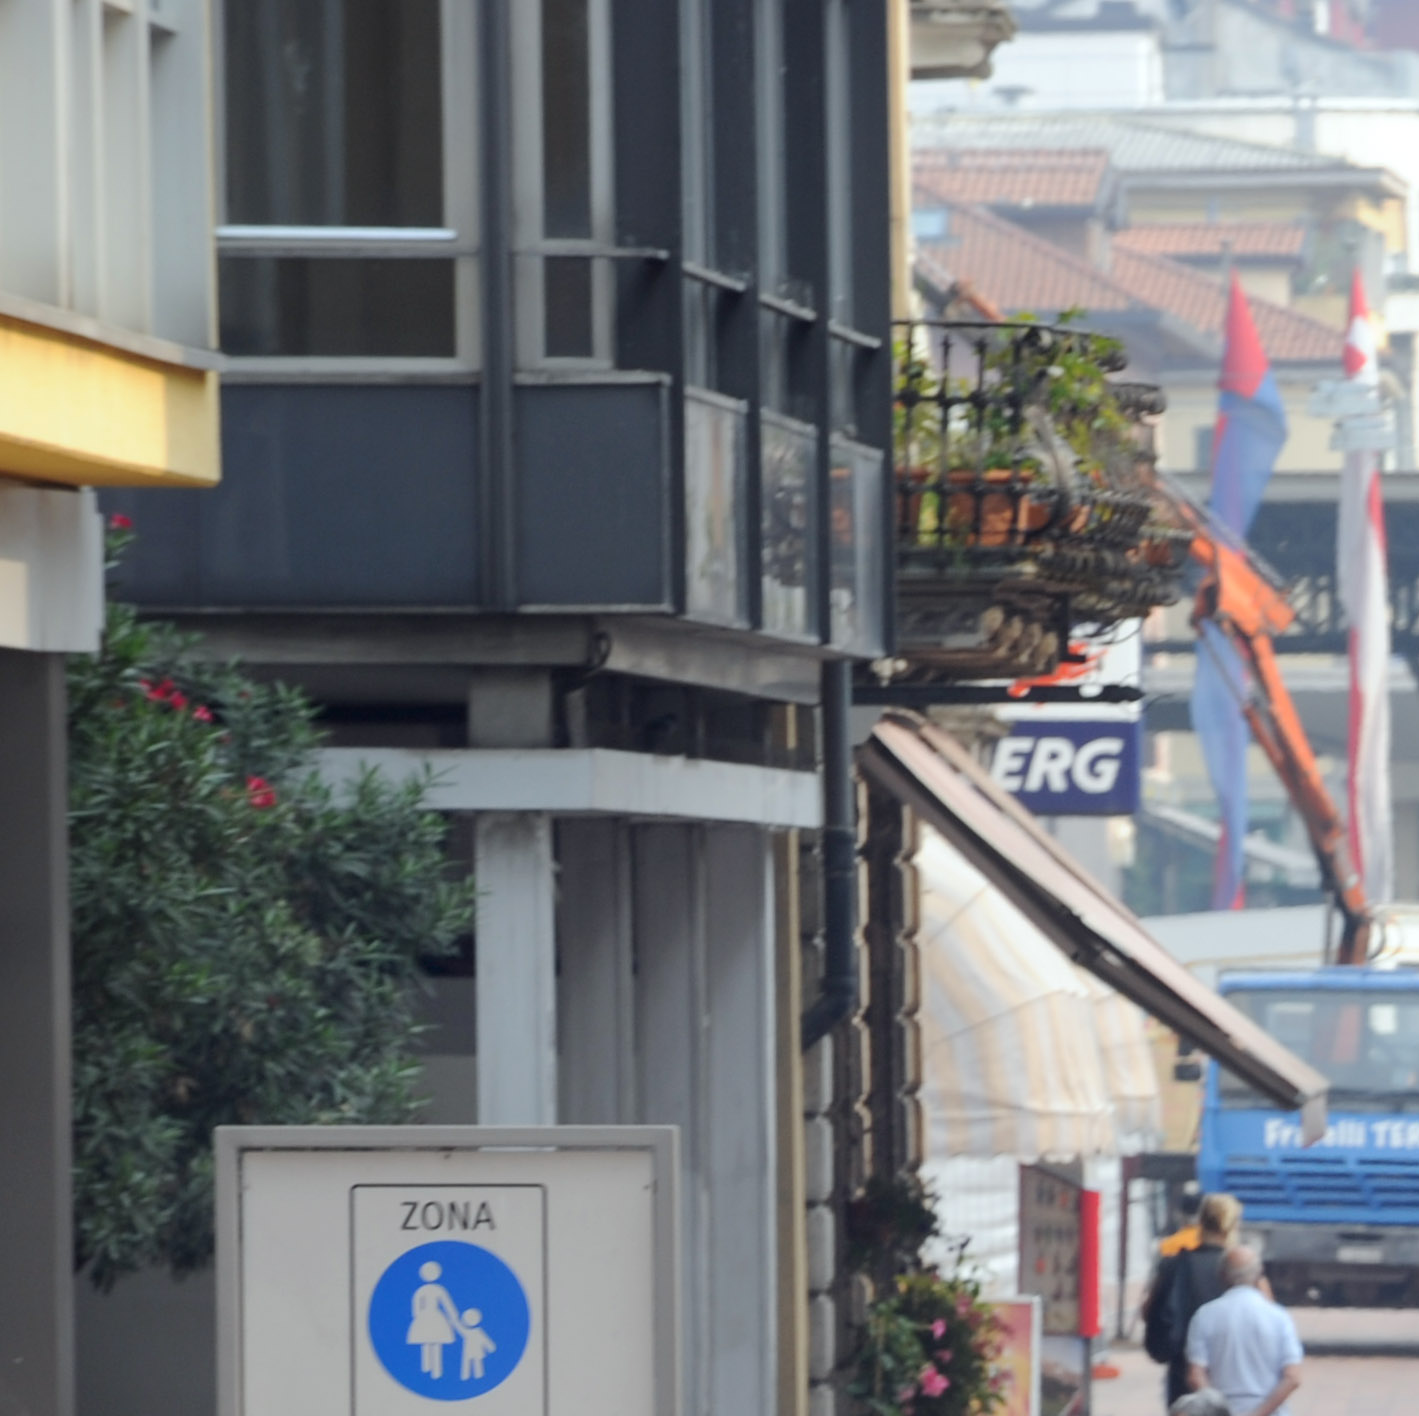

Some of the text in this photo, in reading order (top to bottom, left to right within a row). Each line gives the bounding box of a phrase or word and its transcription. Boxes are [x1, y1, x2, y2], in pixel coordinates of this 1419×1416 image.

[990, 736, 1125, 793] ERG
[1264, 1117, 1365, 1149] Frelli
[401, 1201, 497, 1232] ZONA
